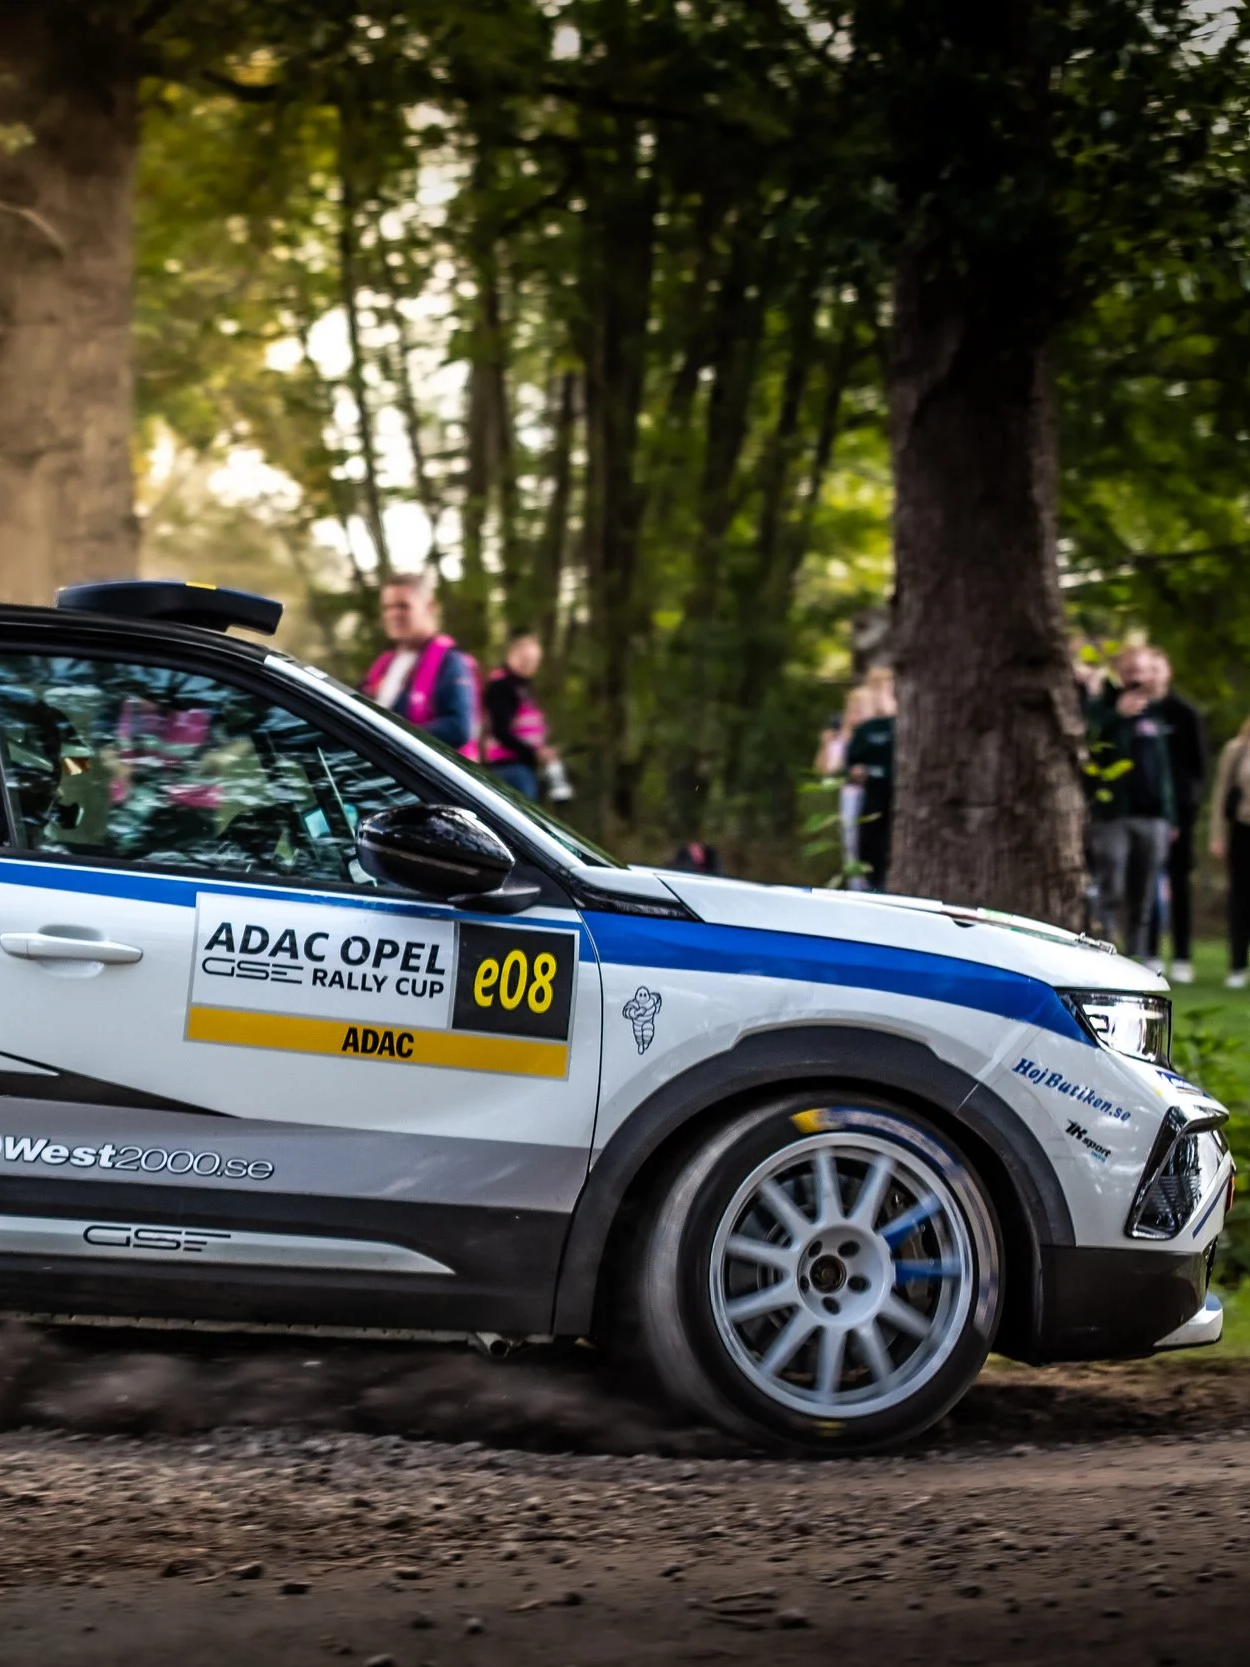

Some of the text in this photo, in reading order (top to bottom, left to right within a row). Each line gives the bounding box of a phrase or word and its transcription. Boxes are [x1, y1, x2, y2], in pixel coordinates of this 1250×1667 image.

[204, 922, 446, 976] ADAC OPEL
[202, 957, 445, 999] GSE RALLY CUP
[474, 949, 558, 1015] e08
[341, 1027, 414, 1058] ADAC
[4, 1135, 275, 1181] West2000.se
